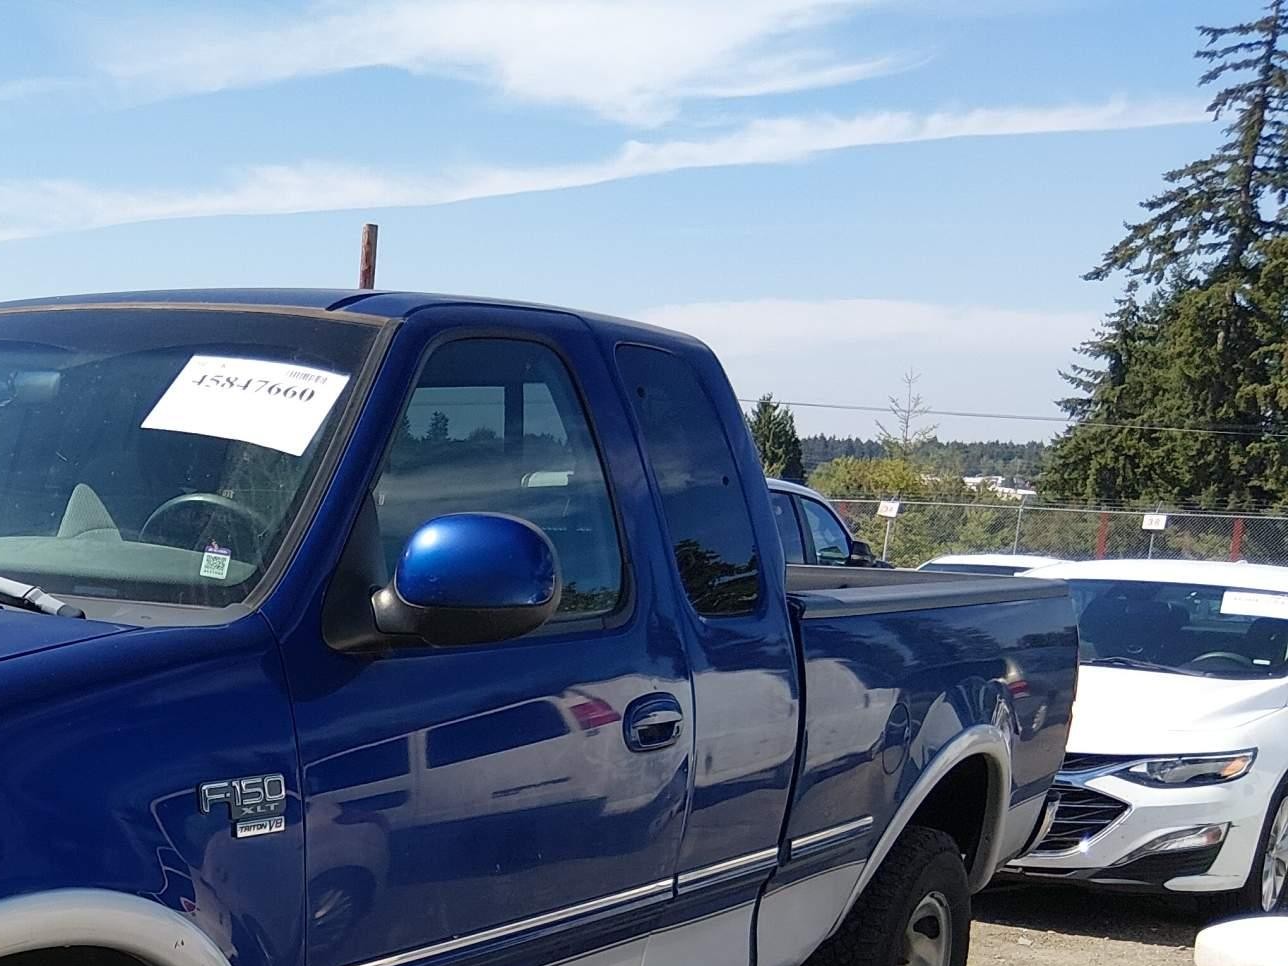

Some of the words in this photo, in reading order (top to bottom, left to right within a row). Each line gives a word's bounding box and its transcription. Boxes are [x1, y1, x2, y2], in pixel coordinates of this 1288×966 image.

[191, 374, 316, 402] 45847660
[242, 803, 279, 815] XLT
[239, 823, 268, 833] TRITON
[268, 817, 283, 832] V8
